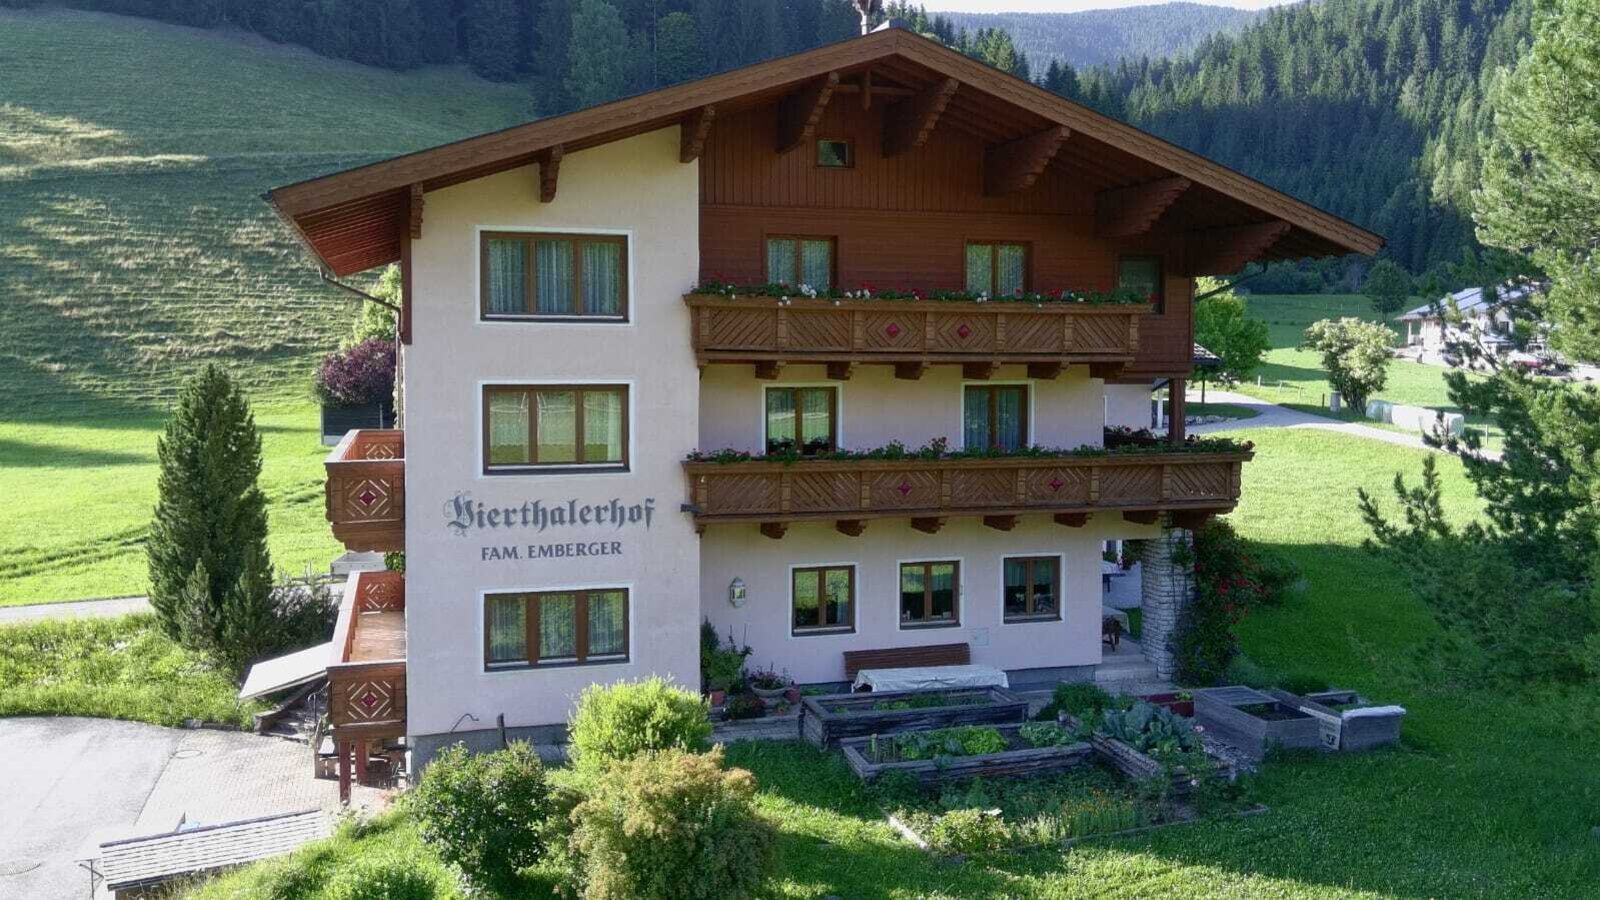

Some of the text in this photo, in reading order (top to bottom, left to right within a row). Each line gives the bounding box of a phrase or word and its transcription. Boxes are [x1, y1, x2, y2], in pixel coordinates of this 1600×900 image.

[445, 491, 655, 535] Vierthalerhof
[481, 541, 623, 561] FAM. EMBERGER
